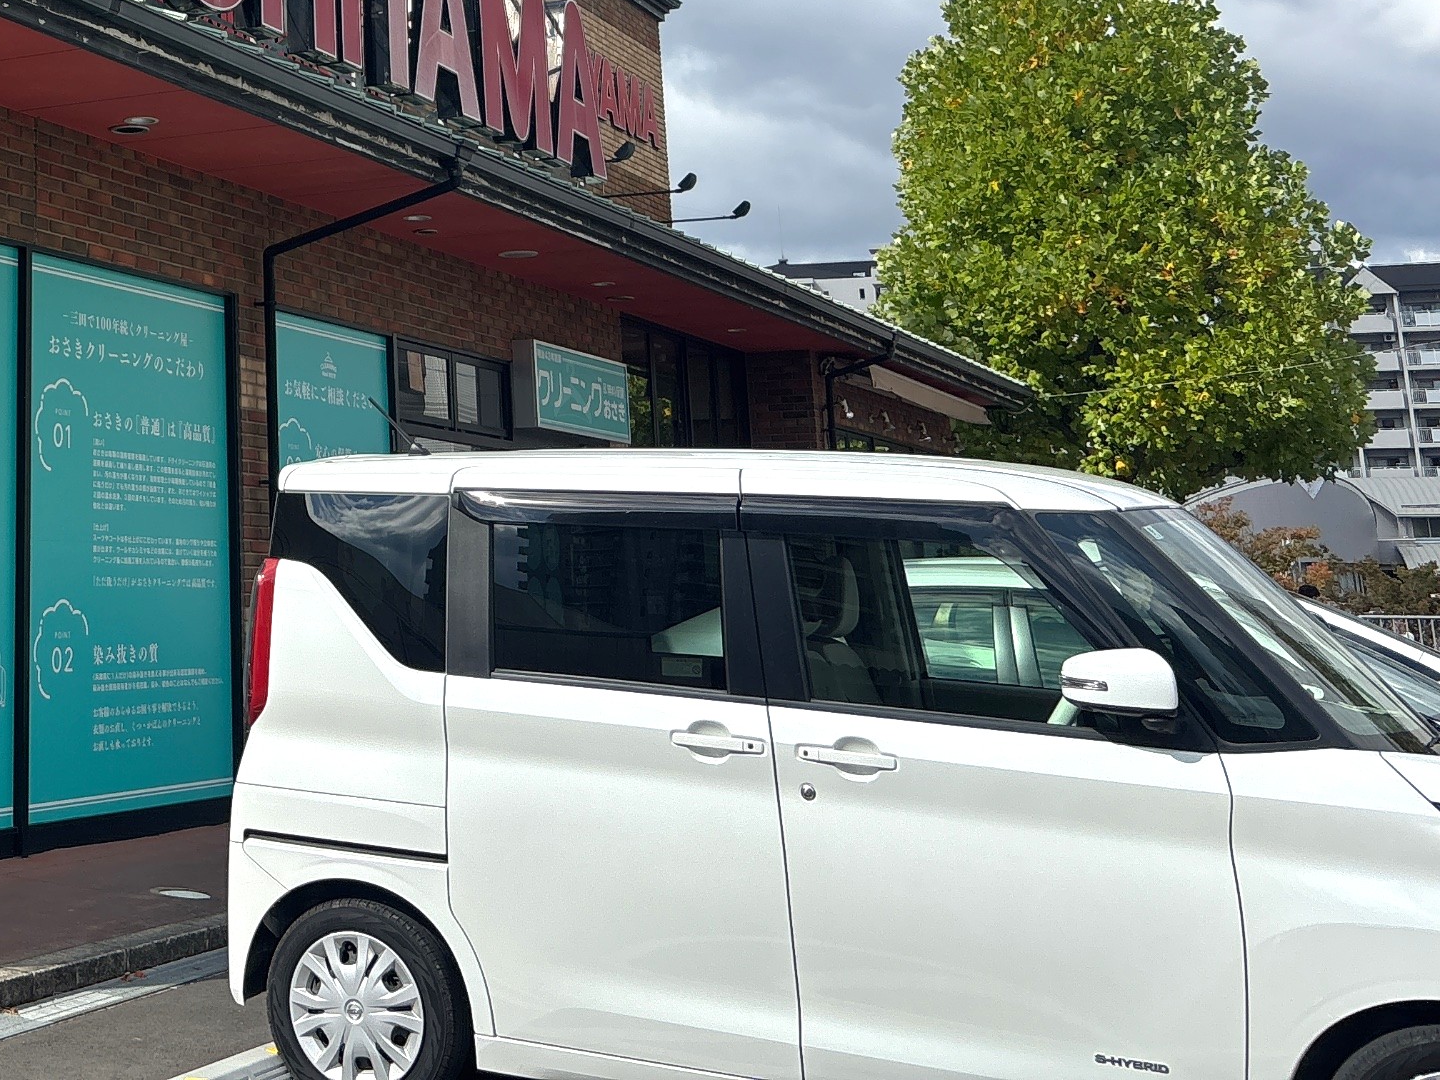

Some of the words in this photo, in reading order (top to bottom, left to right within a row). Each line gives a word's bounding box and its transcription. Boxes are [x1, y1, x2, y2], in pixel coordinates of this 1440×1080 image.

[48, 335, 205, 381] おさきクリーニングのこだわり
[538, 369, 603, 418] クリーニング
[603, 399, 626, 423] おさき
[53, 422, 72, 449] 01
[54, 631, 71, 639] POINT
[51, 646, 74, 673] 02
[93, 642, 159, 665] 染み抜きの質
[1094, 1053, 1171, 1075] S-HYBRID
